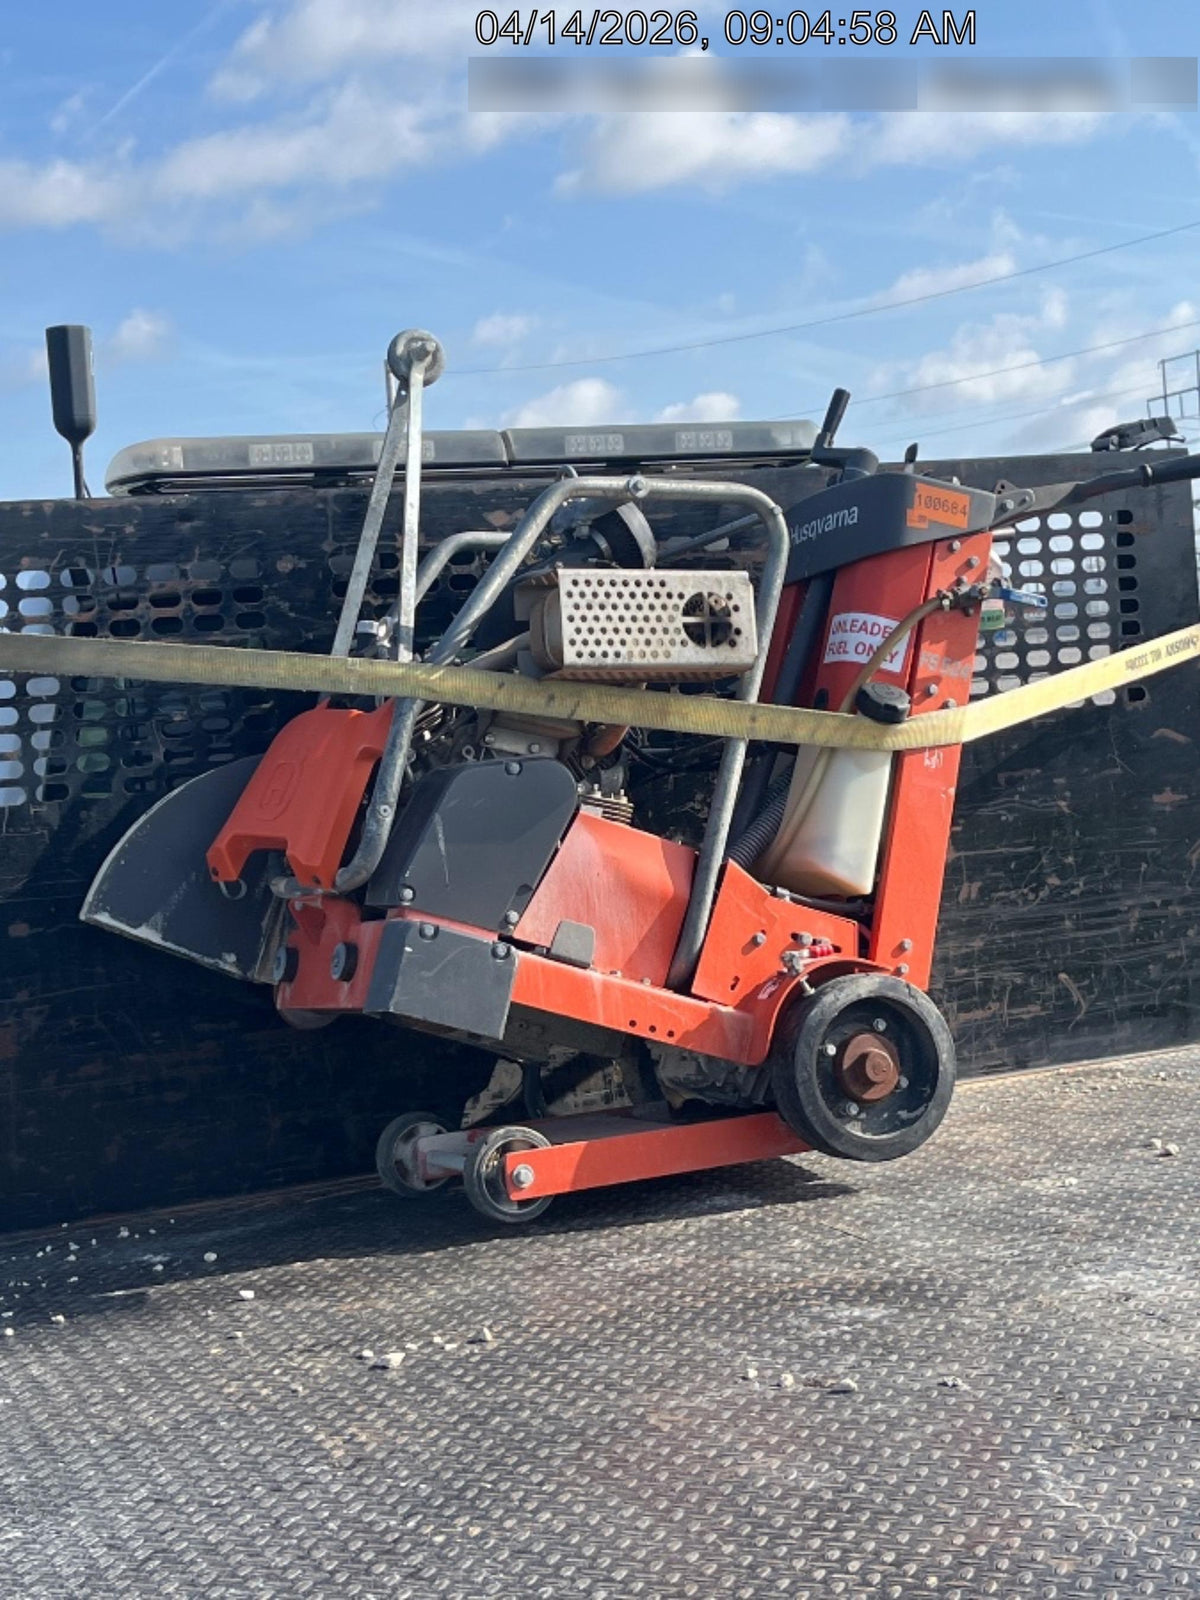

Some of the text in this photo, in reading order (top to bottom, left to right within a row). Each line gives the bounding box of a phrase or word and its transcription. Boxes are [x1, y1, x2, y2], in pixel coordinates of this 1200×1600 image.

[916, 493, 968, 518] 100684
[790, 506, 859, 545] Husqvarna
[831, 618, 894, 640] UNLEADE
[854, 640, 899, 664] ONY
